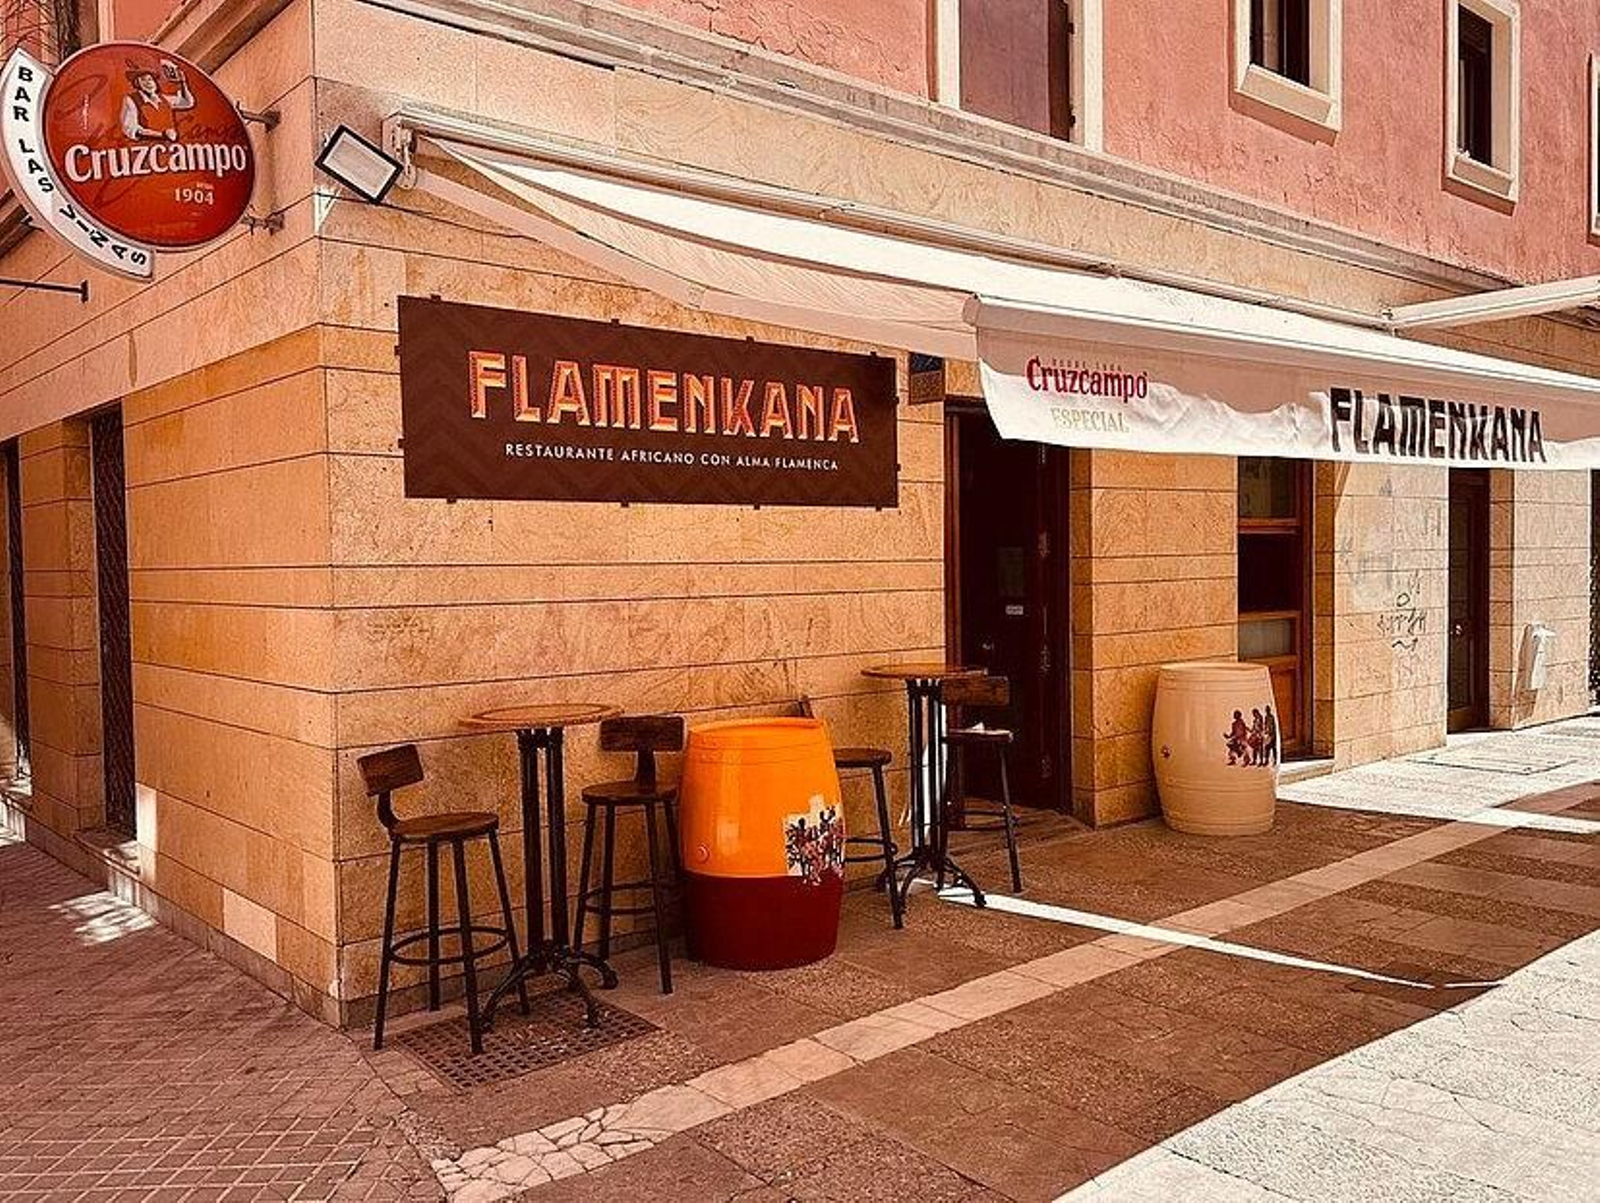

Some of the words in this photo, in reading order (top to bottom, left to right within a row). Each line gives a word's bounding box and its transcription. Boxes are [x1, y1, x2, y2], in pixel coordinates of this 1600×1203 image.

[13, 66, 34, 122] BAR
[18, 138, 54, 193] LAS
[64, 143, 247, 182] Cruzcampo
[174, 187, 214, 205] 1904
[59, 204, 147, 265] VIÑAS
[468, 350, 860, 444] FLAMENKANA
[1026, 356, 1148, 403] Cruzcampo
[1049, 407, 1130, 433] ESPECIAL
[1329, 387, 1547, 463] FLAMENKANA
[504, 443, 615, 461] RESTAURANTE
[620, 449, 696, 466] AFRICANO
[700, 453, 731, 466] CON
[735, 456, 771, 468] ALMA
[773, 457, 839, 471] FLAMENCA
